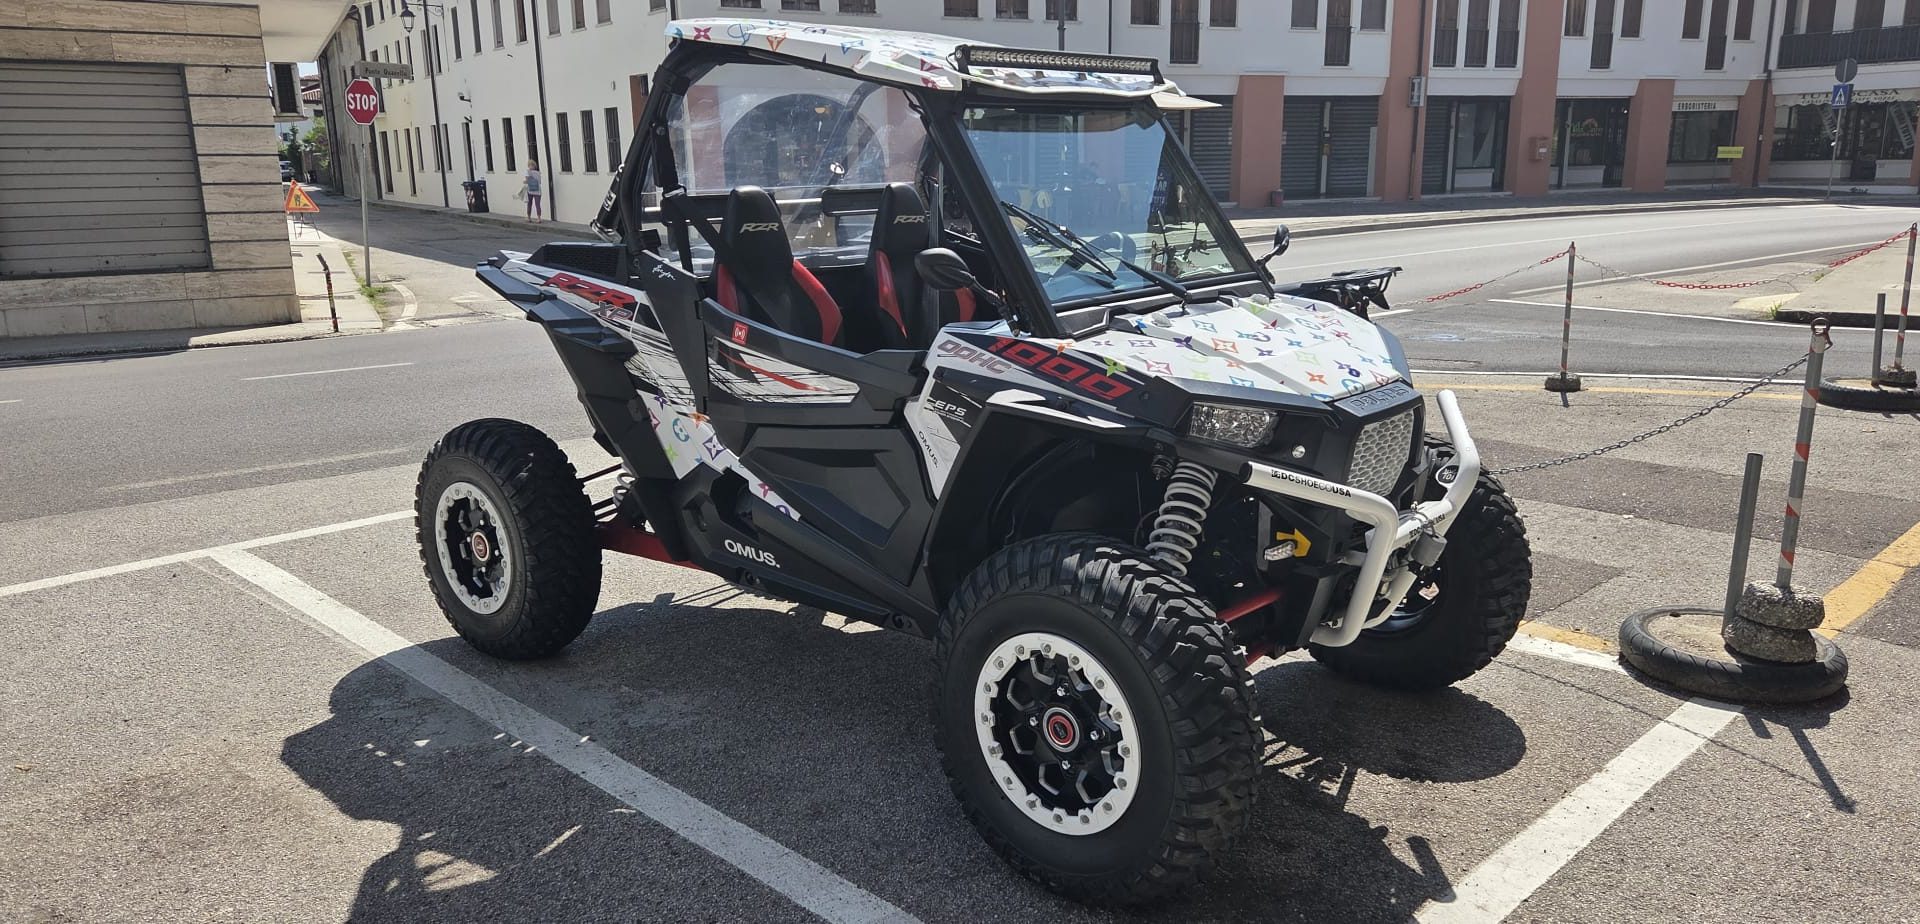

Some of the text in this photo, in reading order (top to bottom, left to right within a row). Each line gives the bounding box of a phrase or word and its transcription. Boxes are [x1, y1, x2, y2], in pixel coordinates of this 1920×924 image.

[347, 93, 377, 111] STOP
[1801, 89, 1899, 99] TUTCASA
[1677, 102, 1717, 110] ERBORISTERIA
[739, 222, 780, 234] RZR
[893, 215, 926, 225] RZR
[544, 272, 636, 308] RZR
[590, 301, 634, 319] XP
[987, 336, 1134, 400] 1000
[934, 400, 968, 417] EPS
[724, 539, 781, 569] OMUS.
